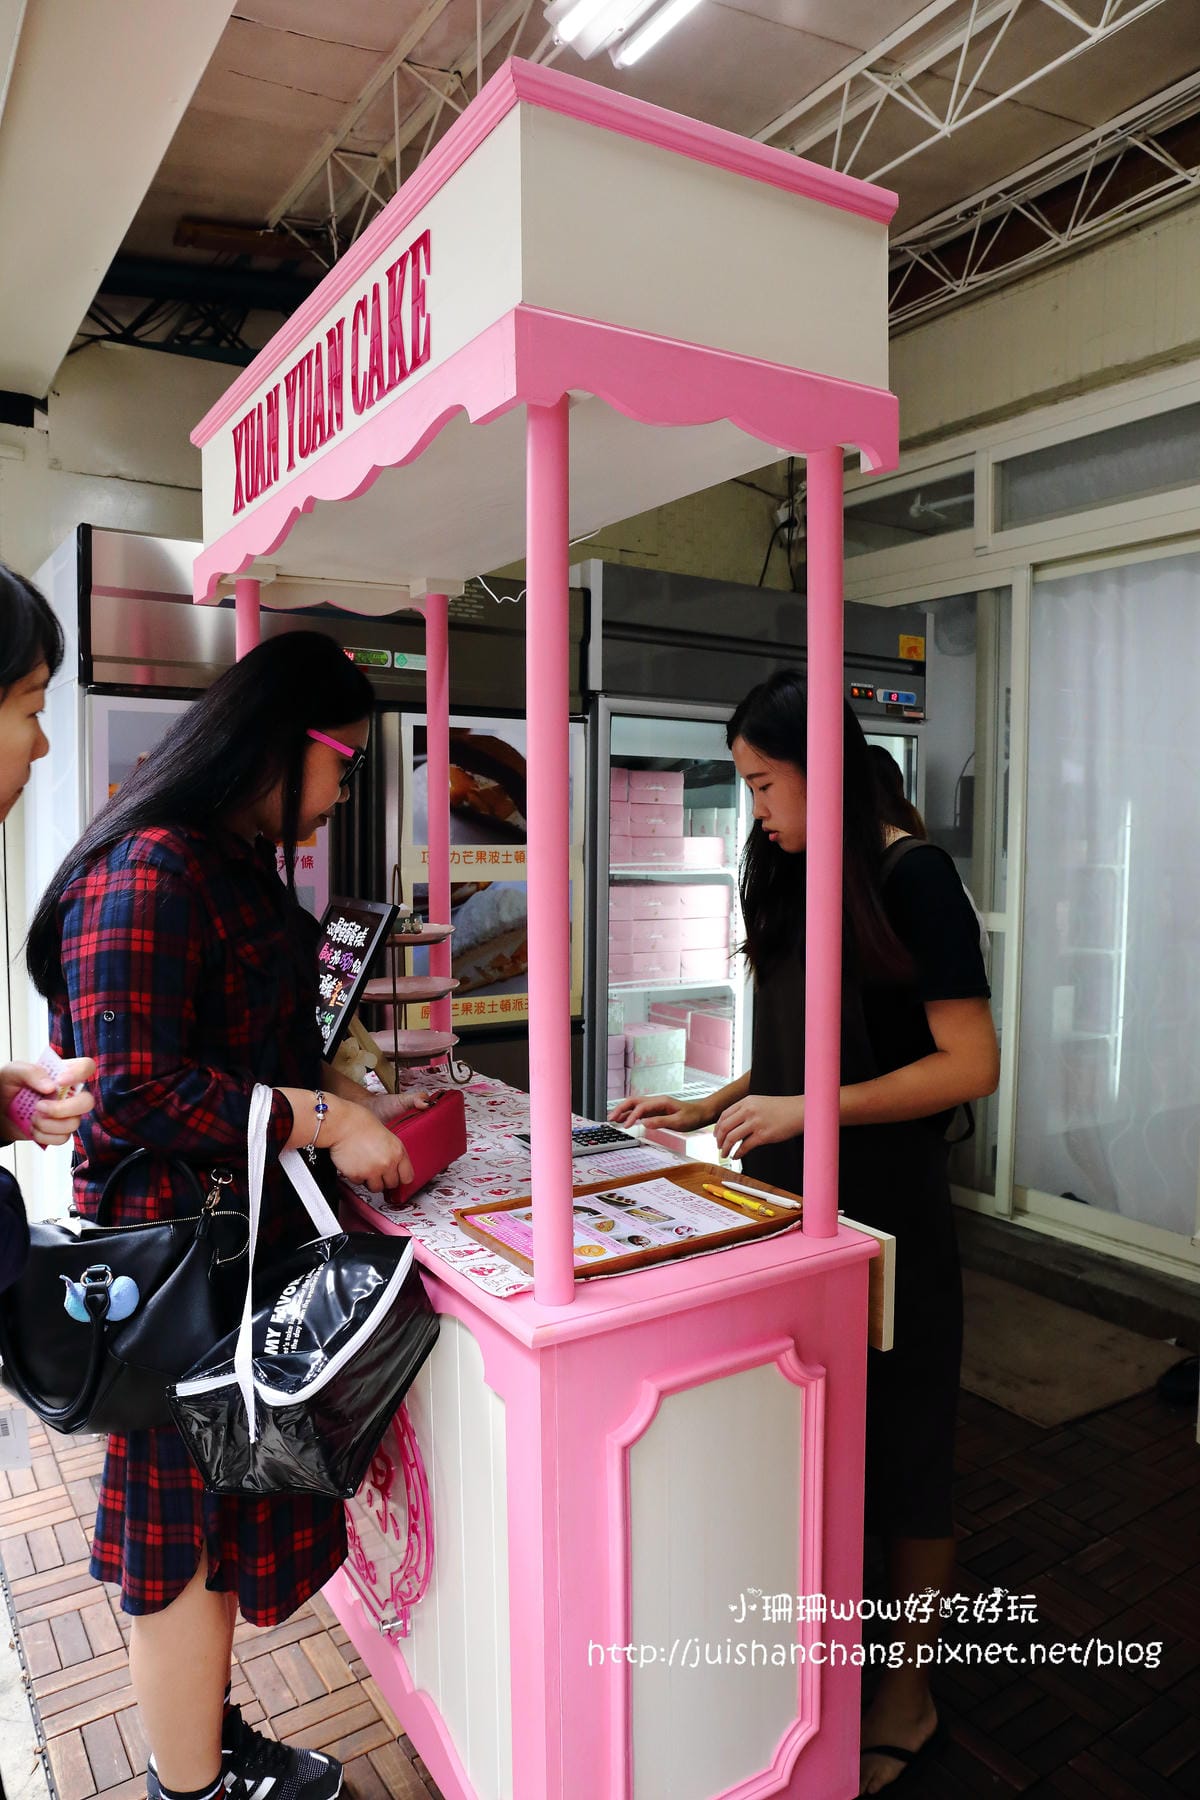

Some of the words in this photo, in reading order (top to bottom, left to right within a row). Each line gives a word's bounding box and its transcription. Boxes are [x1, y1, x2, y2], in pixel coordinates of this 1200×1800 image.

[232, 383, 281, 516] XUAN
[284, 317, 346, 472] YUAN
[351, 229, 431, 415] CAKE
[264, 1327, 281, 1355] MY
[293, 1325, 302, 1338] day
